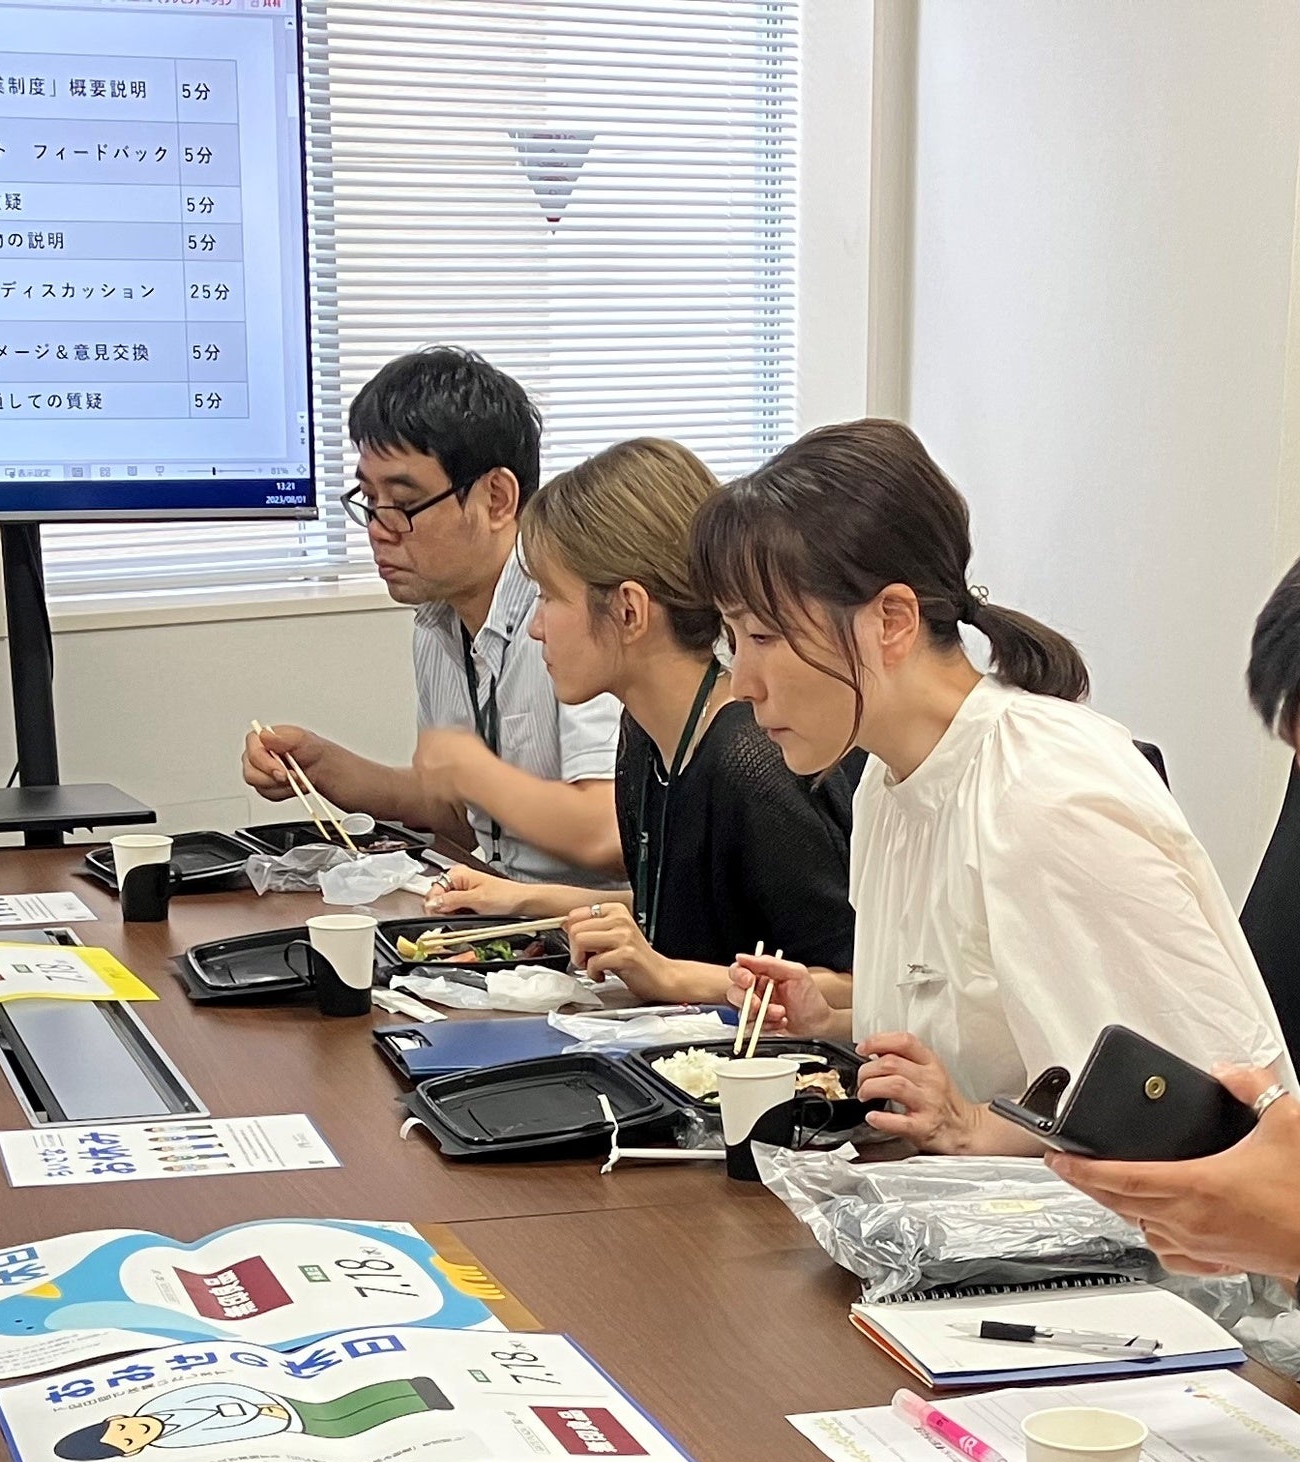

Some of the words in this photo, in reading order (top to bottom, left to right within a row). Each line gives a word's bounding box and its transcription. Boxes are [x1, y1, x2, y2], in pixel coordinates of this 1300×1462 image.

[181, 81, 211, 101] 5分
[33, 143, 169, 164] フィードバック
[184, 145, 213, 165] 5分
[186, 195, 215, 214] 5分
[187, 233, 217, 252] 5分
[189, 283, 230, 301] 25分
[192, 343, 221, 361] 5分
[194, 393, 222, 410] 5分
[276, 481, 295, 491] 13:21
[77, 1131, 136, 1175] お休み
[337, 1256, 420, 1300] 7.18
[201, 1270, 258, 1320] 無印良品
[490, 1349, 562, 1386] 7.18
[558, 1409, 618, 1453] 無印良品
